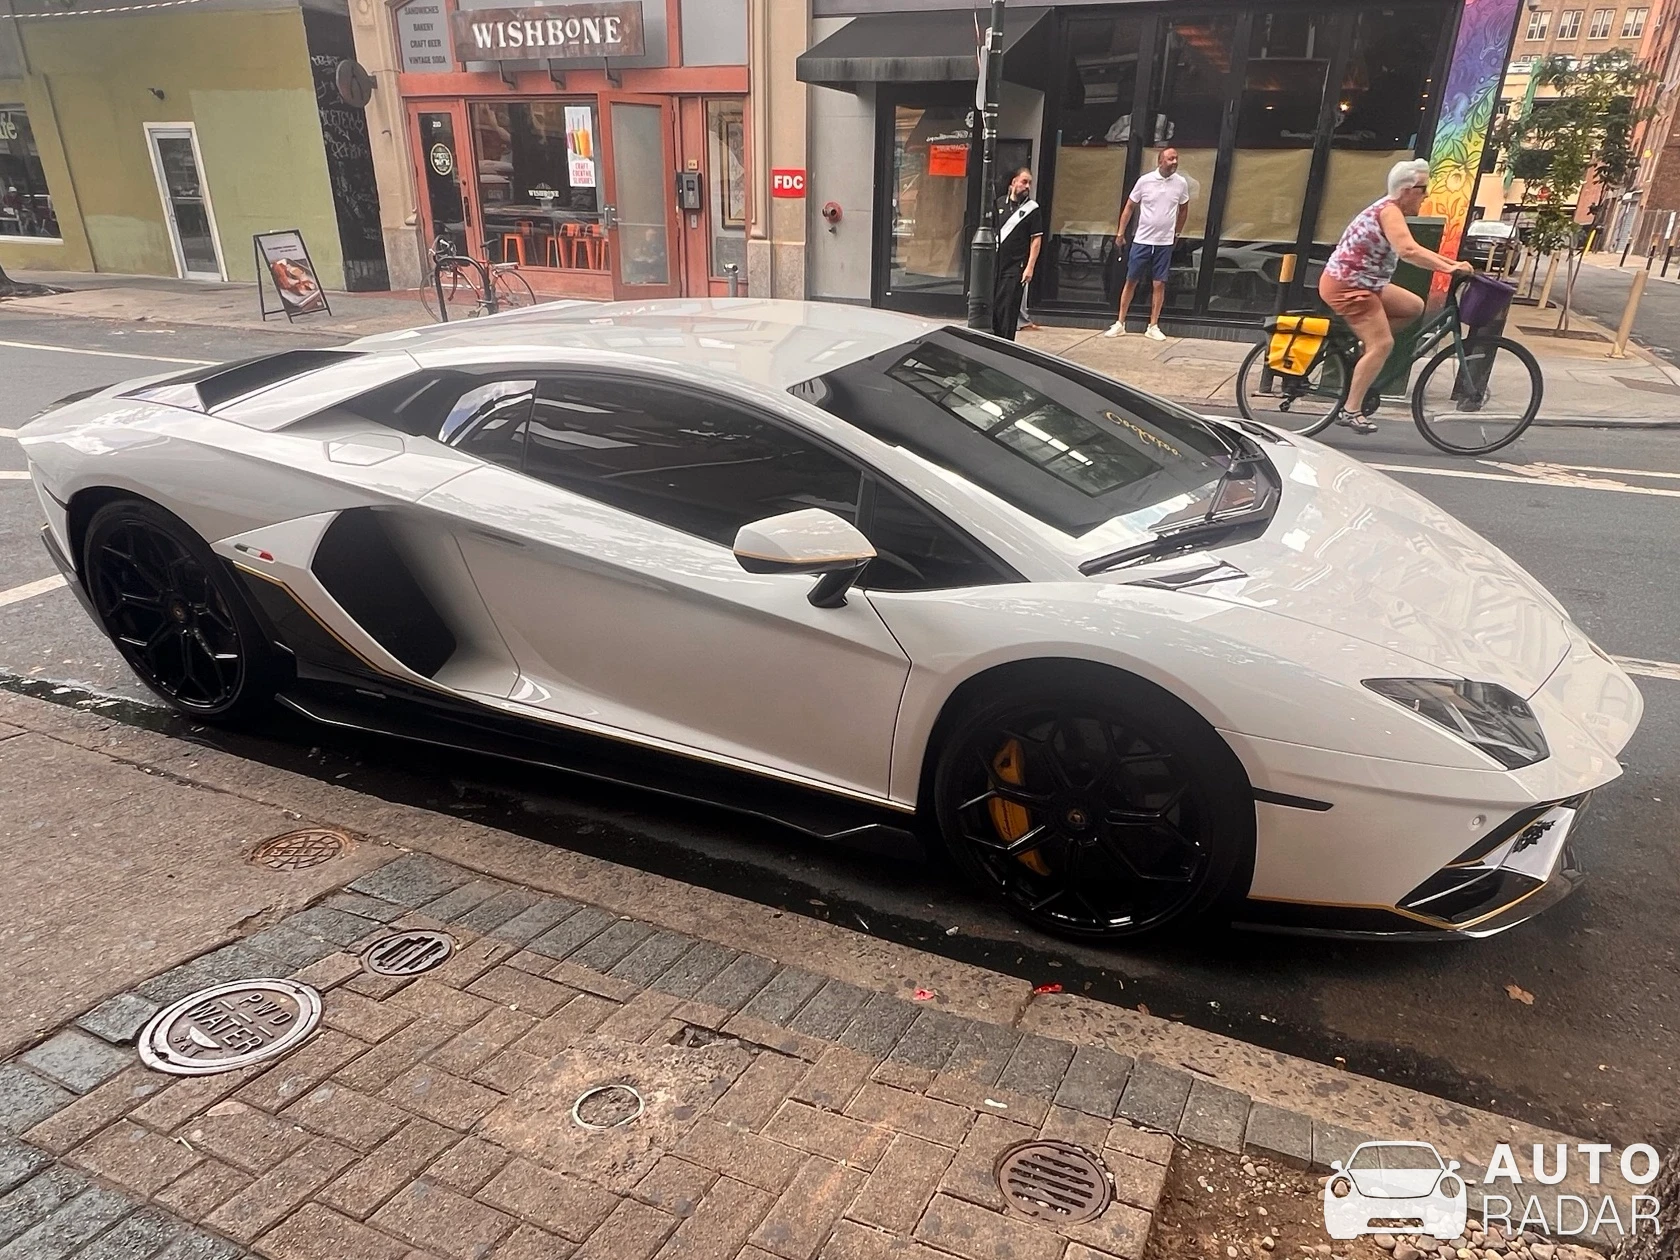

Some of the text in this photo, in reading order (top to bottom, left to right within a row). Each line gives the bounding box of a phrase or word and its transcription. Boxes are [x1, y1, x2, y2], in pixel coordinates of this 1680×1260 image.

[413, 23, 434, 31] BAKERY
[472, 16, 622, 49] WISHBONE
[410, 39, 441, 48] CRAFT BEER
[409, 55, 446, 64] VINTAGE SODA
[575, 162, 589, 170] CRAFT
[774, 175, 804, 190] FDC
[238, 992, 293, 1025] PWD
[187, 1001, 263, 1054] WATER
